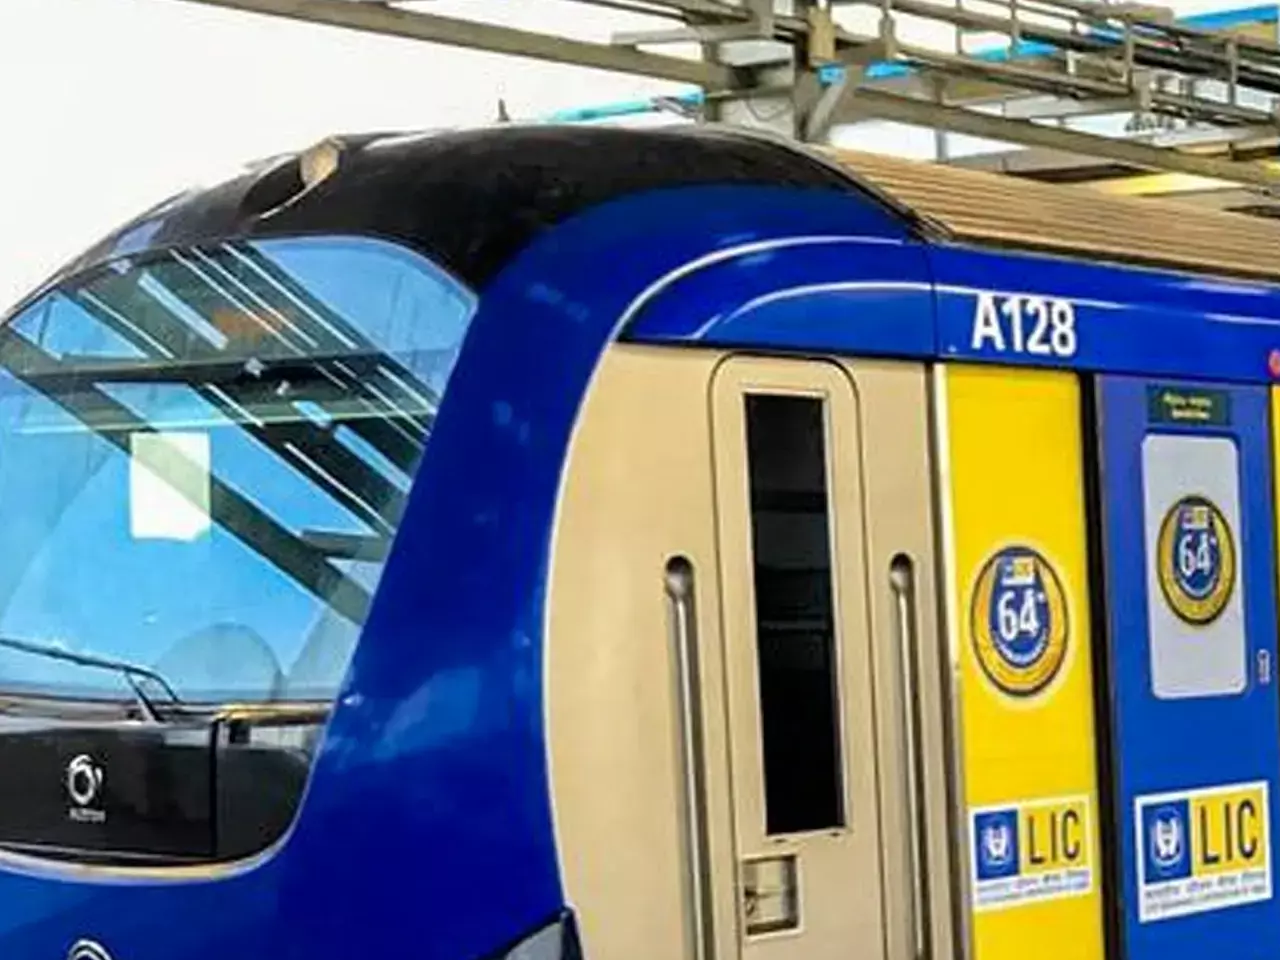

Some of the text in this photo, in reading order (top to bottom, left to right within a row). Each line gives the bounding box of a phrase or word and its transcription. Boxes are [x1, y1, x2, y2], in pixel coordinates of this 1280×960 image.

[971, 293, 1076, 356] A128
[998, 588, 1040, 641] 64
[1028, 809, 1081, 865] LIC
[1200, 799, 1258, 865] LIC
